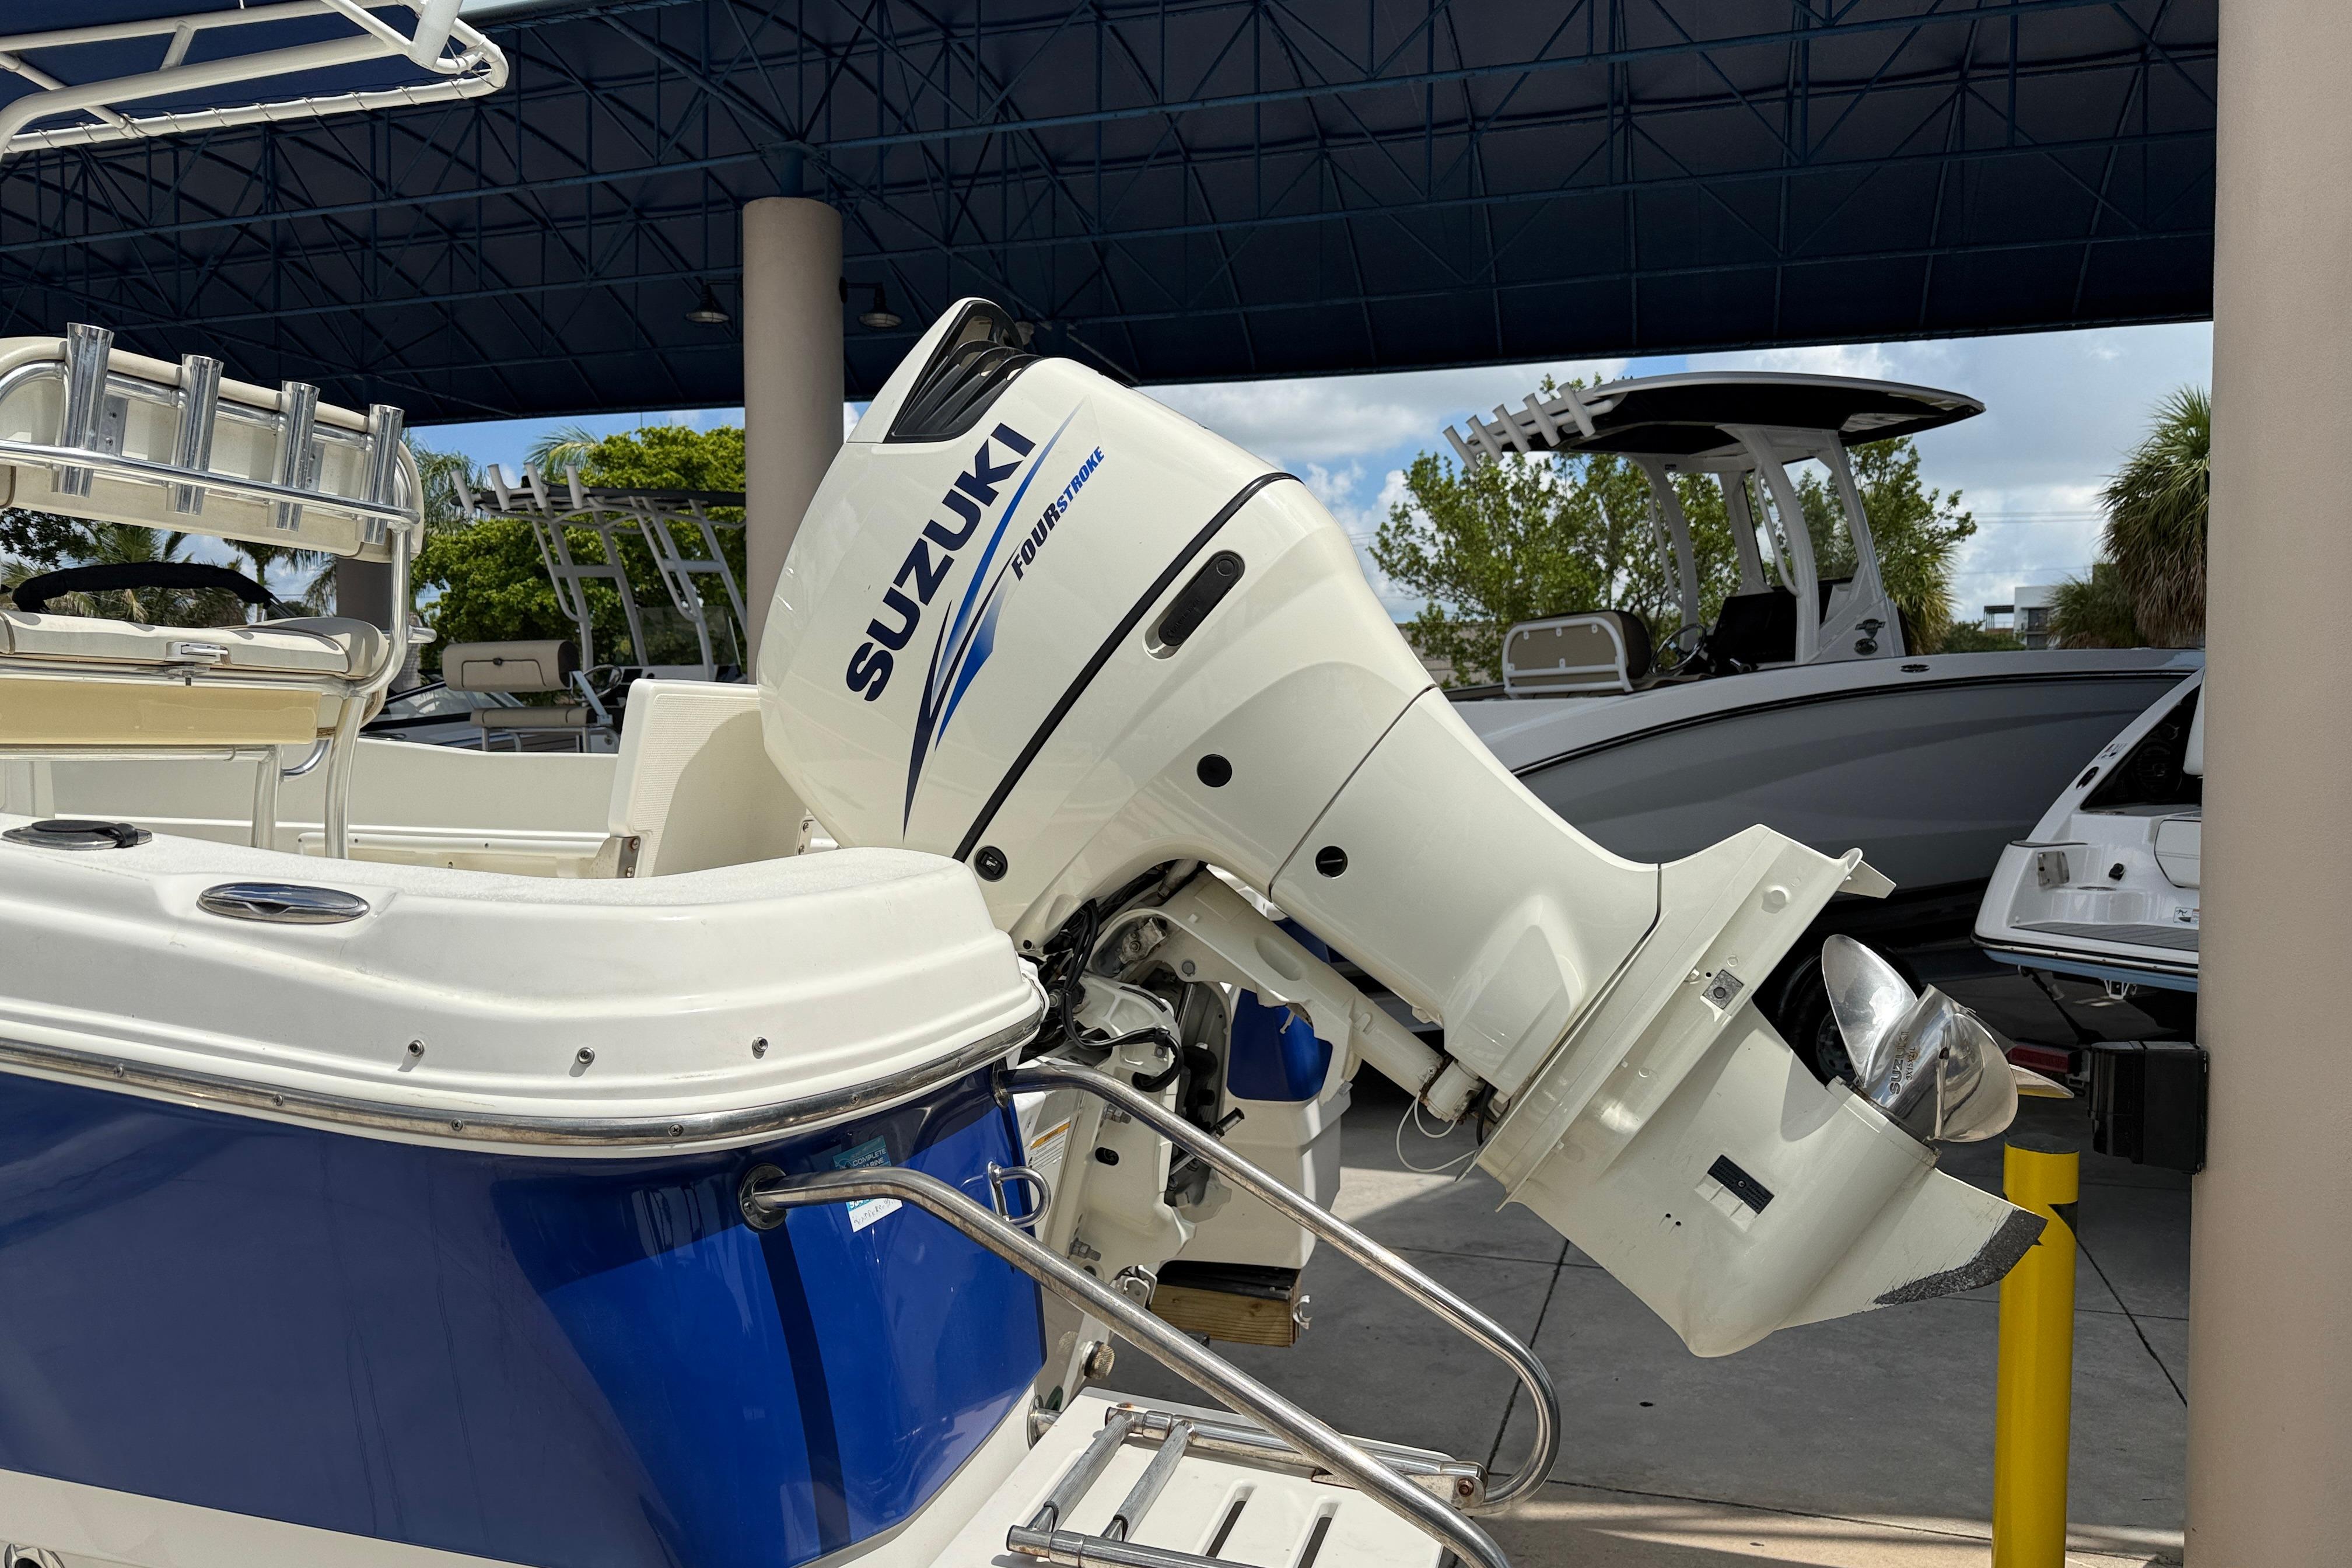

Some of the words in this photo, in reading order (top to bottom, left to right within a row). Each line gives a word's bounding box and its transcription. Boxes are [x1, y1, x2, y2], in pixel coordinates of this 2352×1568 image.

[846, 422, 1037, 702] SUZUKI
[1890, 1031, 1909, 1095] SUZUKI
[852, 1148, 887, 1167] COMPLETE
[863, 1157, 885, 1167] ARINE
